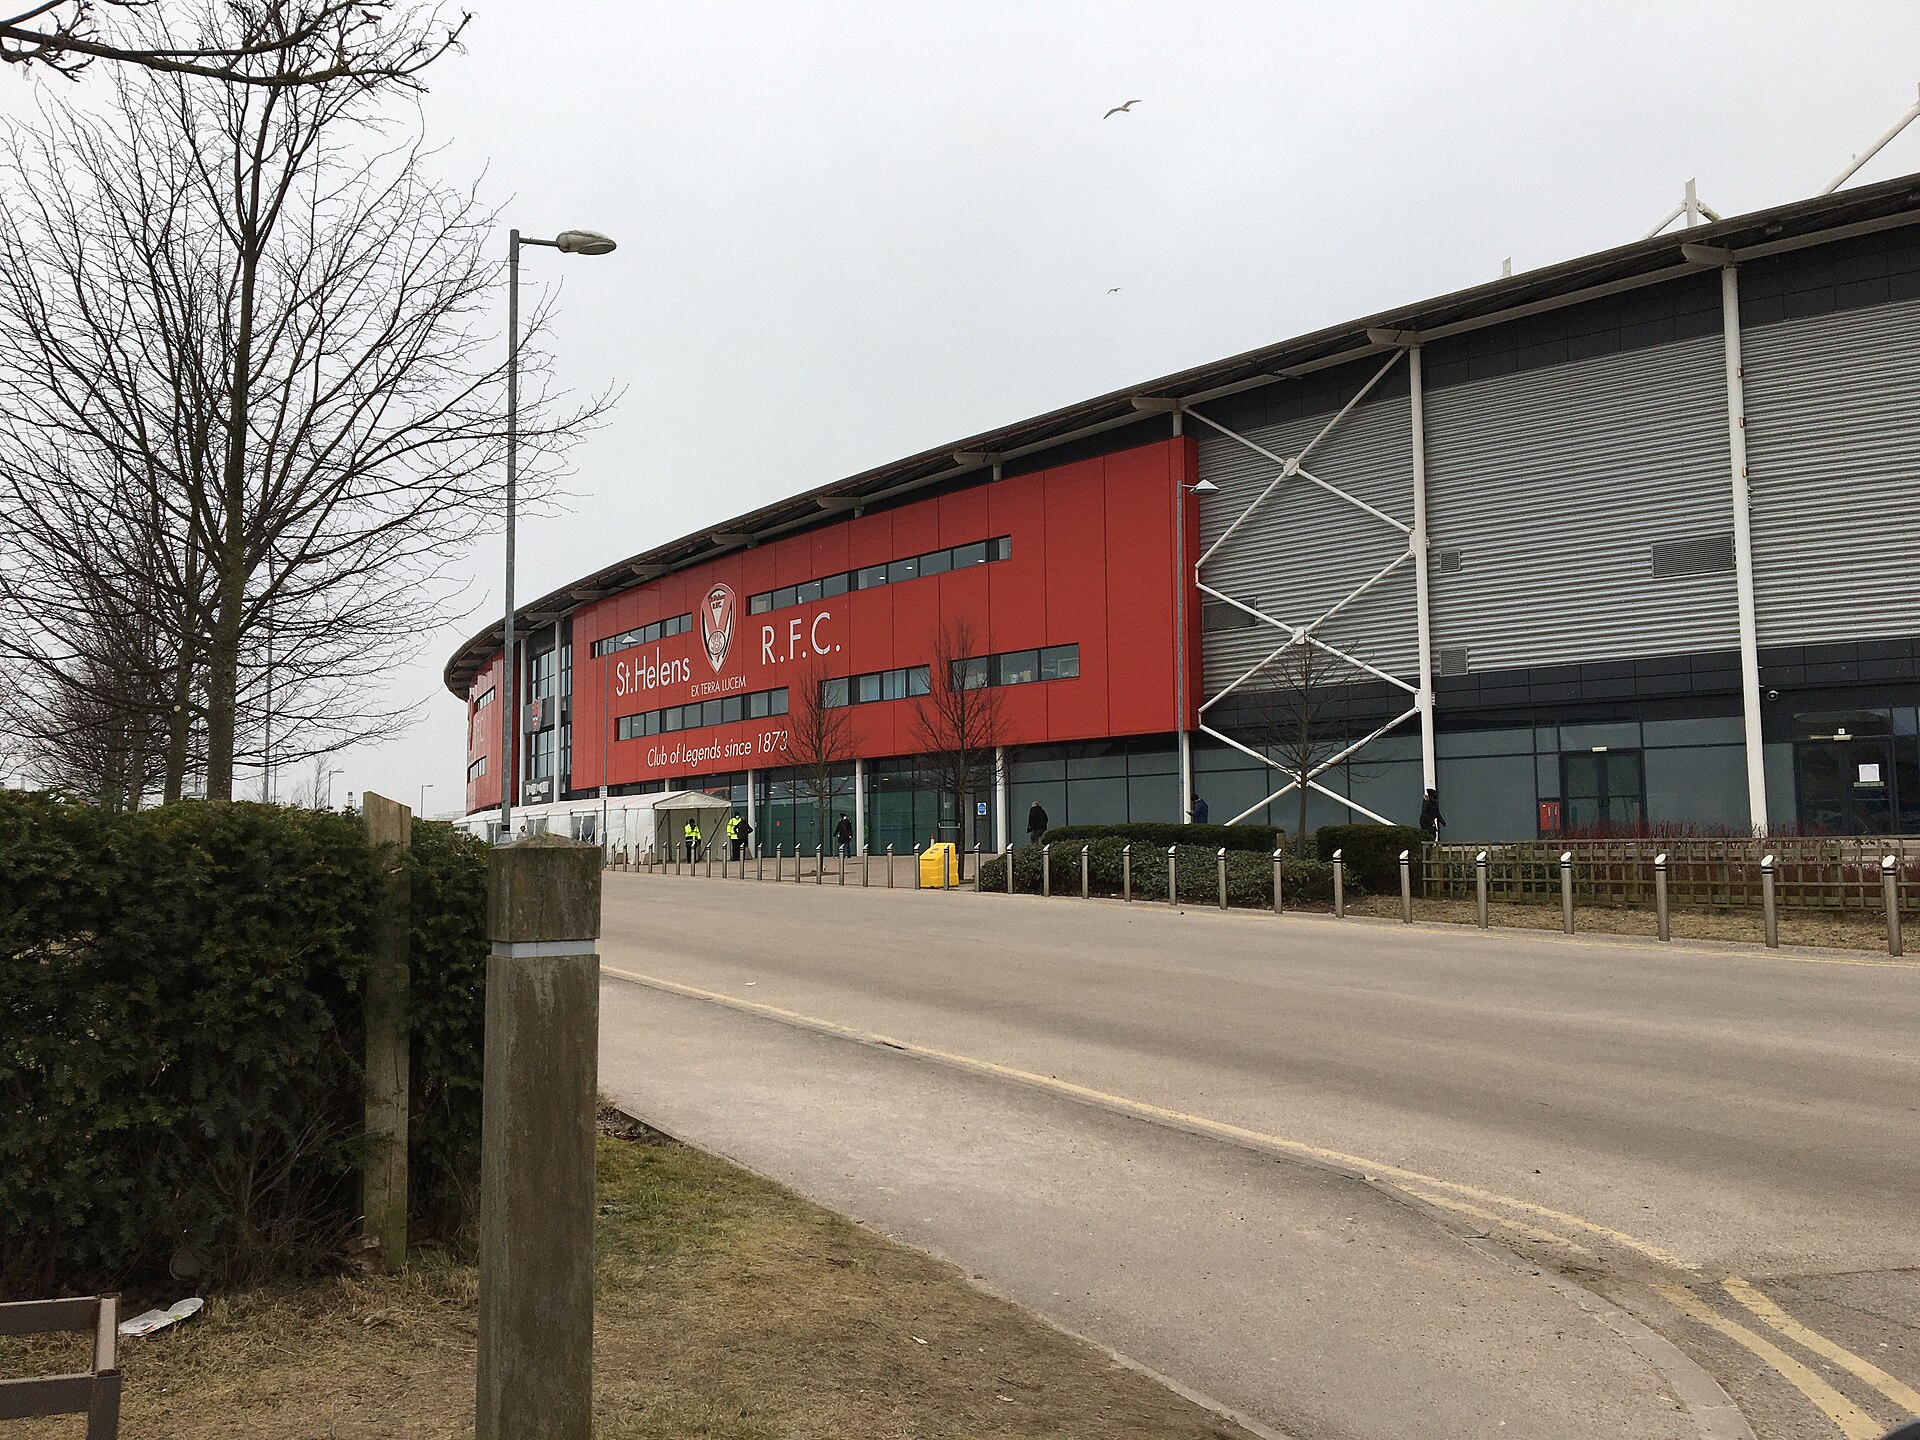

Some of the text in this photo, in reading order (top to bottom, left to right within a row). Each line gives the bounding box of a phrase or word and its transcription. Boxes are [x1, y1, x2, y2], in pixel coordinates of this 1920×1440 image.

[762, 612, 841, 666] R.F.C.
[691, 676, 746, 697] EX TERRA LUCEM
[648, 730, 788, 767] Club of Legends since 1873
